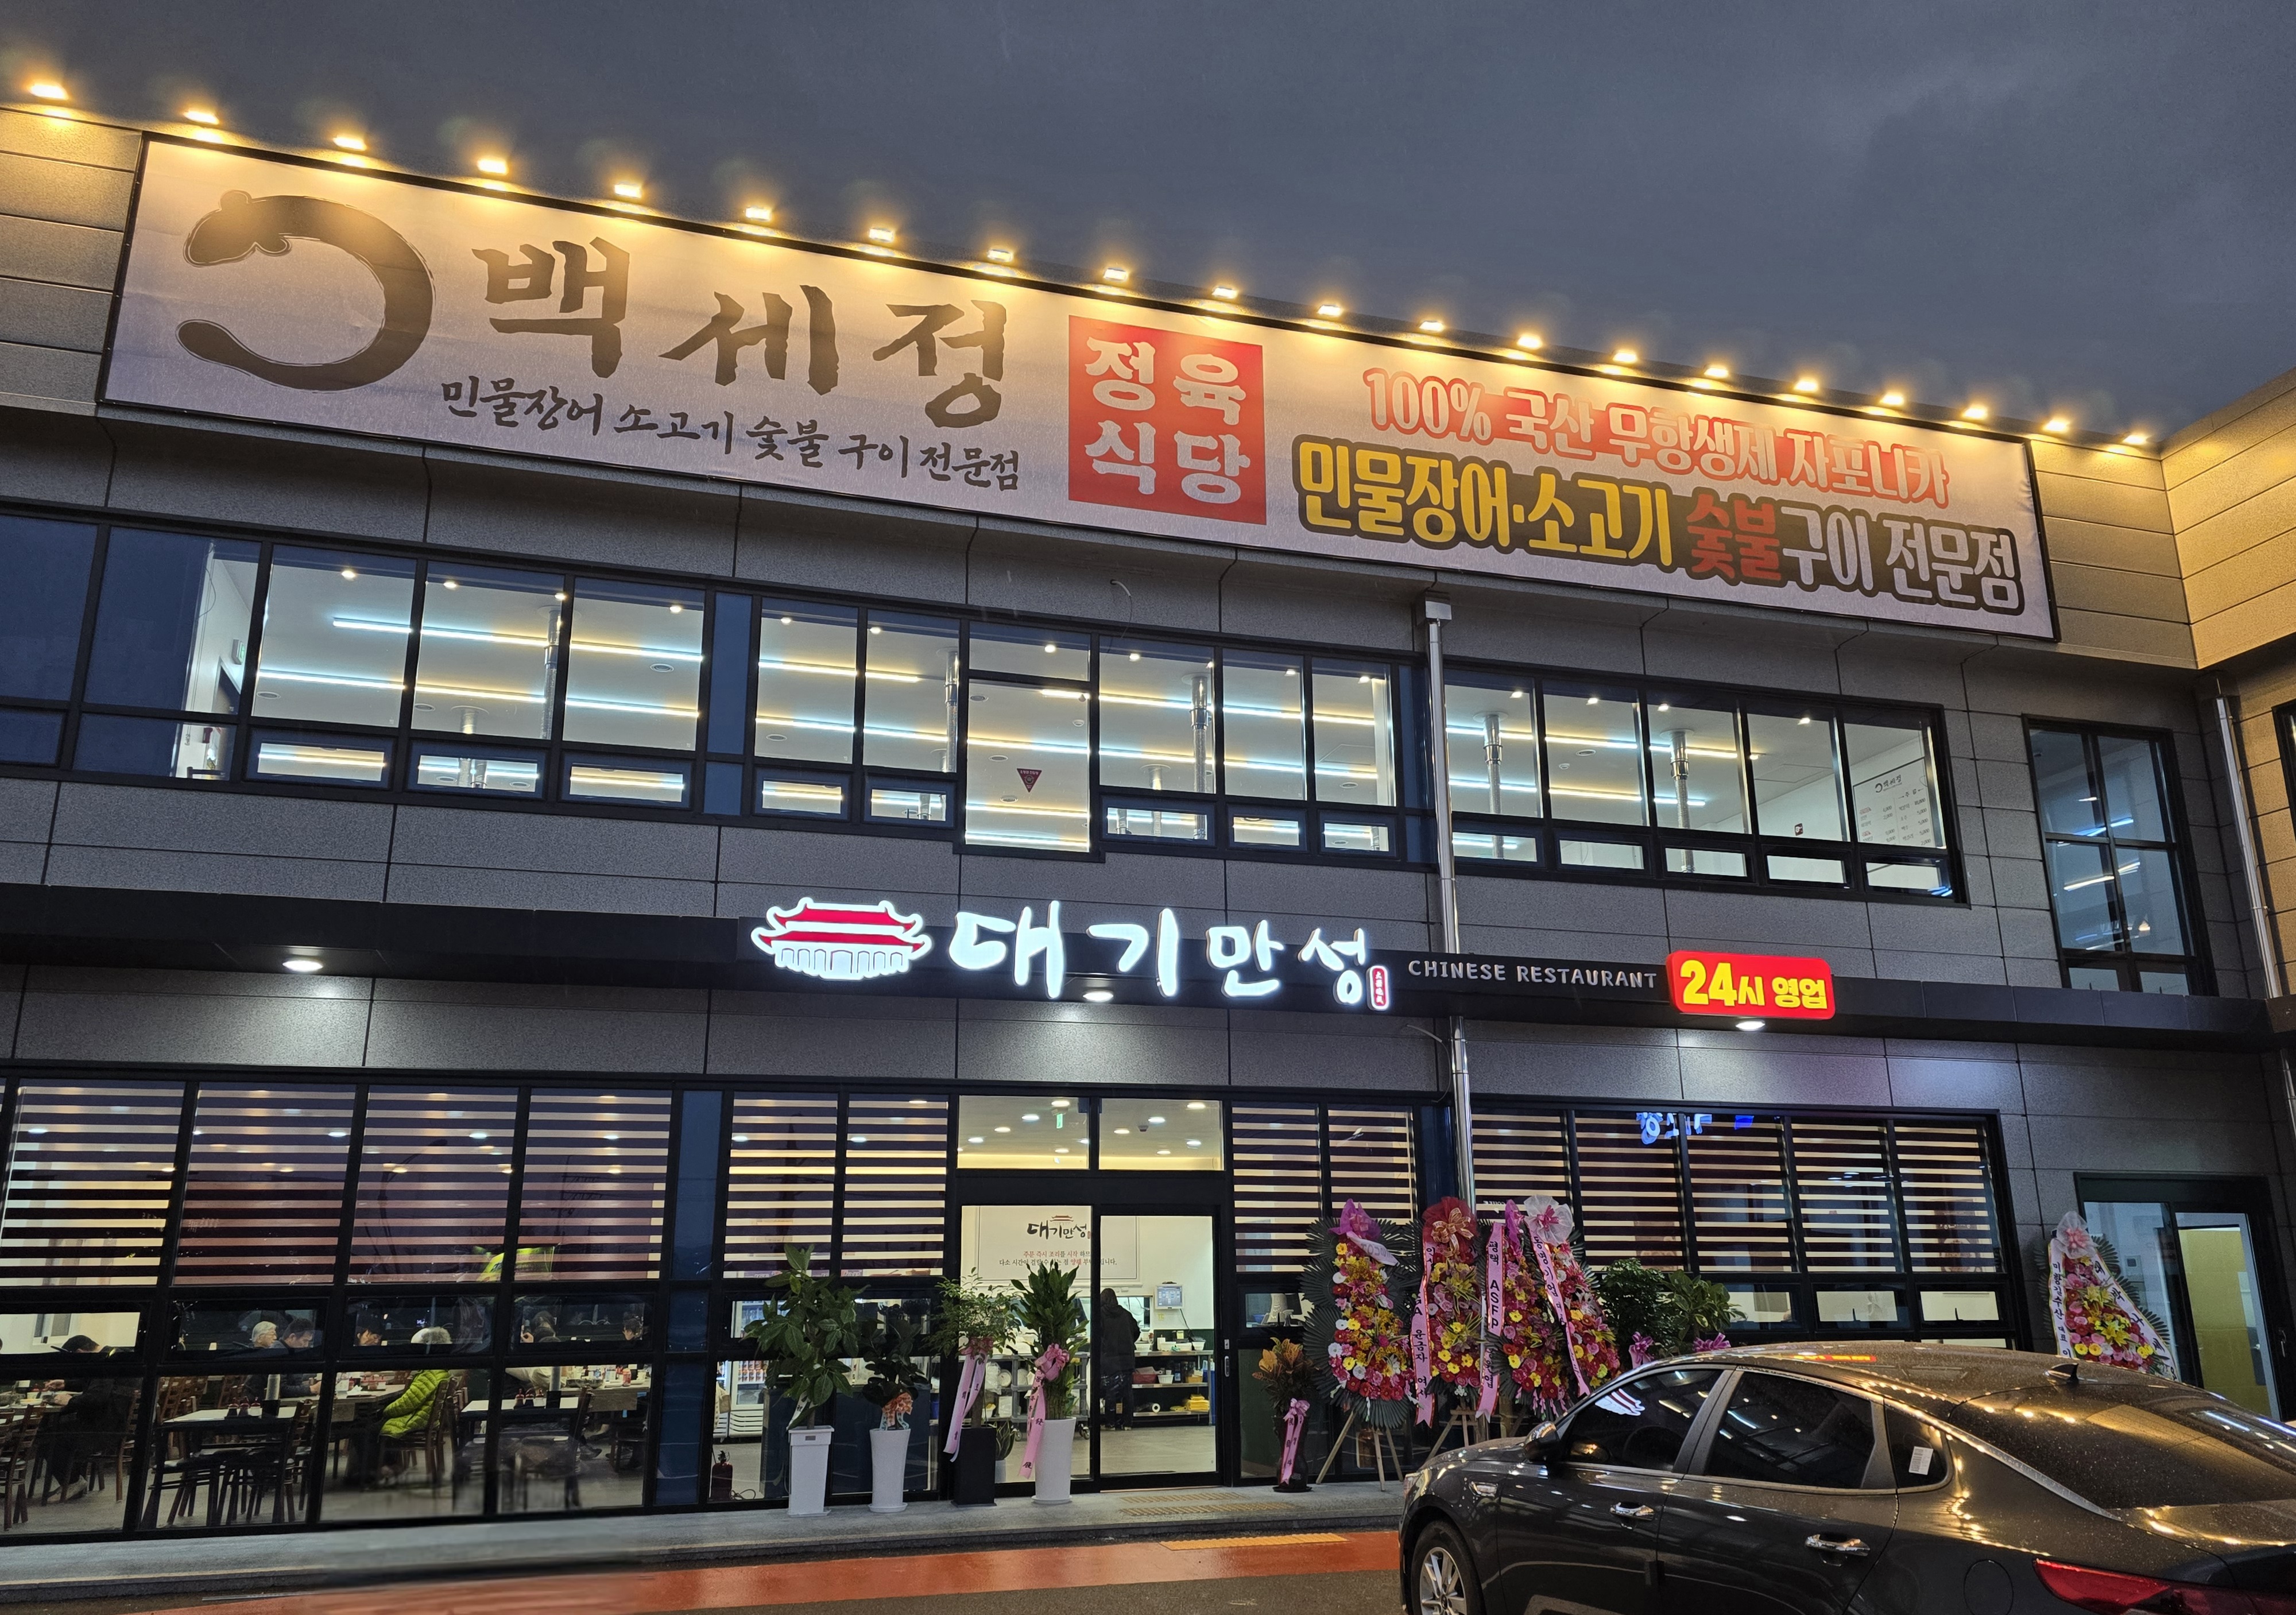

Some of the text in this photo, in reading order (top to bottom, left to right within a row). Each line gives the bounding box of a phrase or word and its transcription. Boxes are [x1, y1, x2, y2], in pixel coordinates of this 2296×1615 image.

[471, 237, 1006, 428] 백세정
[1085, 336, 1246, 426] 정육
[441, 375, 1021, 491] 민물장어 소고기 숯불 구이 전문점
[1084, 420, 1251, 504] 식당
[1364, 368, 1949, 506] 100% 국산 무항생제 자포니카
[1883, 517, 2024, 611] 전문점
[948, 900, 1365, 1005] 대기만성
[1408, 959, 1658, 989] CHINESE RESTAURANT
[1680, 959, 1829, 1010] 24시 영업
[1012, 1258, 1028, 1267] 시간이
[1027, 1220, 1087, 1240] 대기만성
[1534, 1236, 1559, 1297] 동명기업
[1489, 1280, 1500, 1329] ASFP
[2058, 1326, 2067, 1342] 대표
